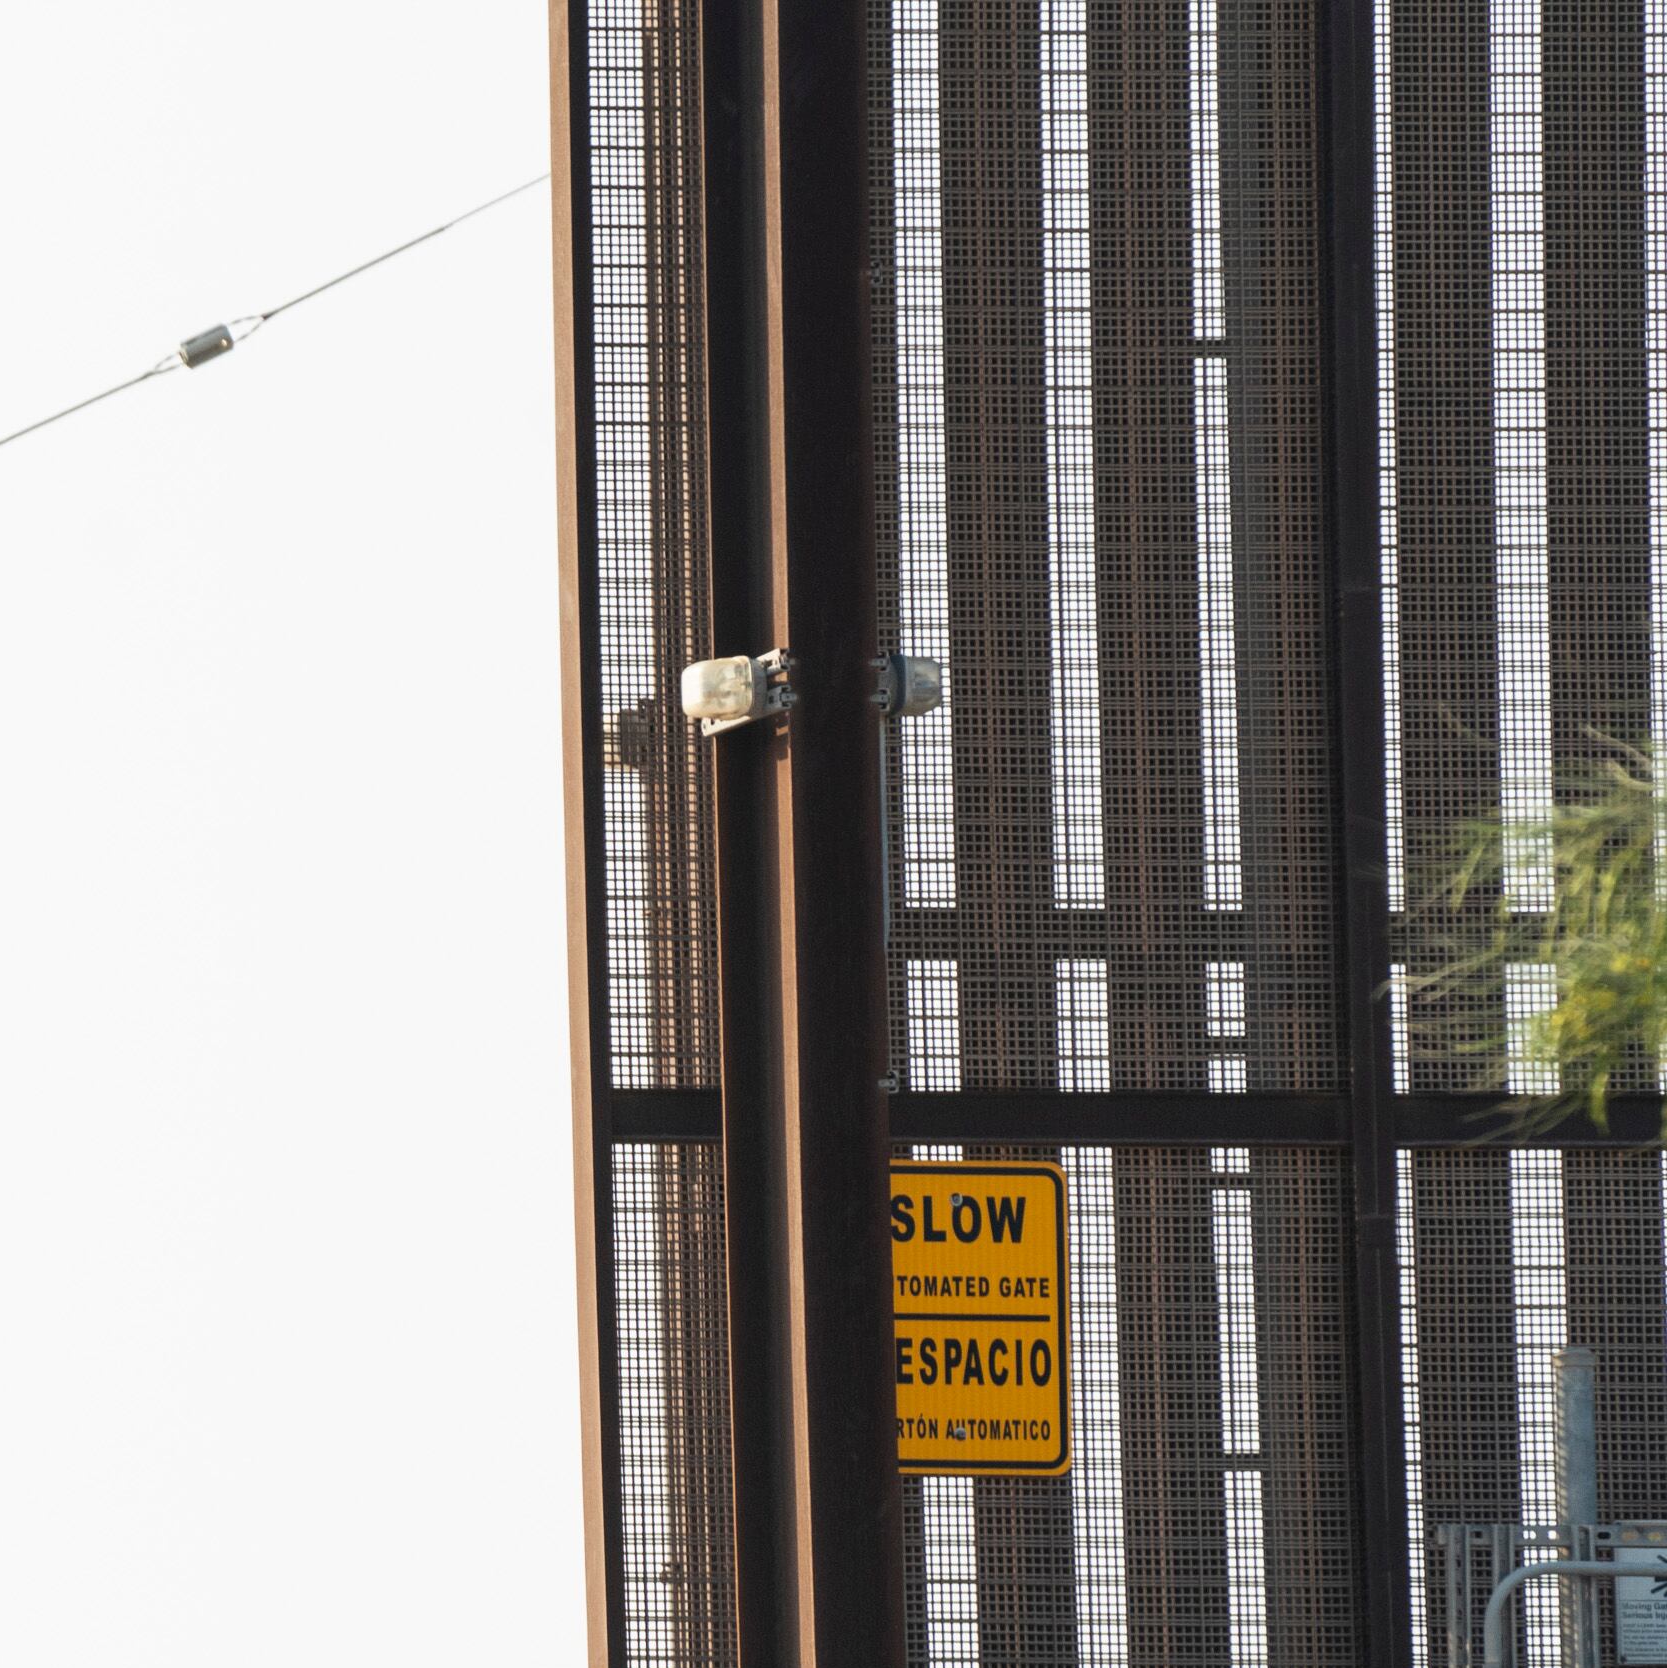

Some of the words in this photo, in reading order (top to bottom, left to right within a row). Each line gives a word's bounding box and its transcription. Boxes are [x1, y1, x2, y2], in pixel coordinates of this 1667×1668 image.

[891, 1194, 1026, 1243] SLOW
[896, 1275, 990, 1297] TOMATED
[999, 1276, 1050, 1298] GATE
[896, 1337, 1052, 1387] ESPACIO
[896, 1412, 938, 1440] RTÓN
